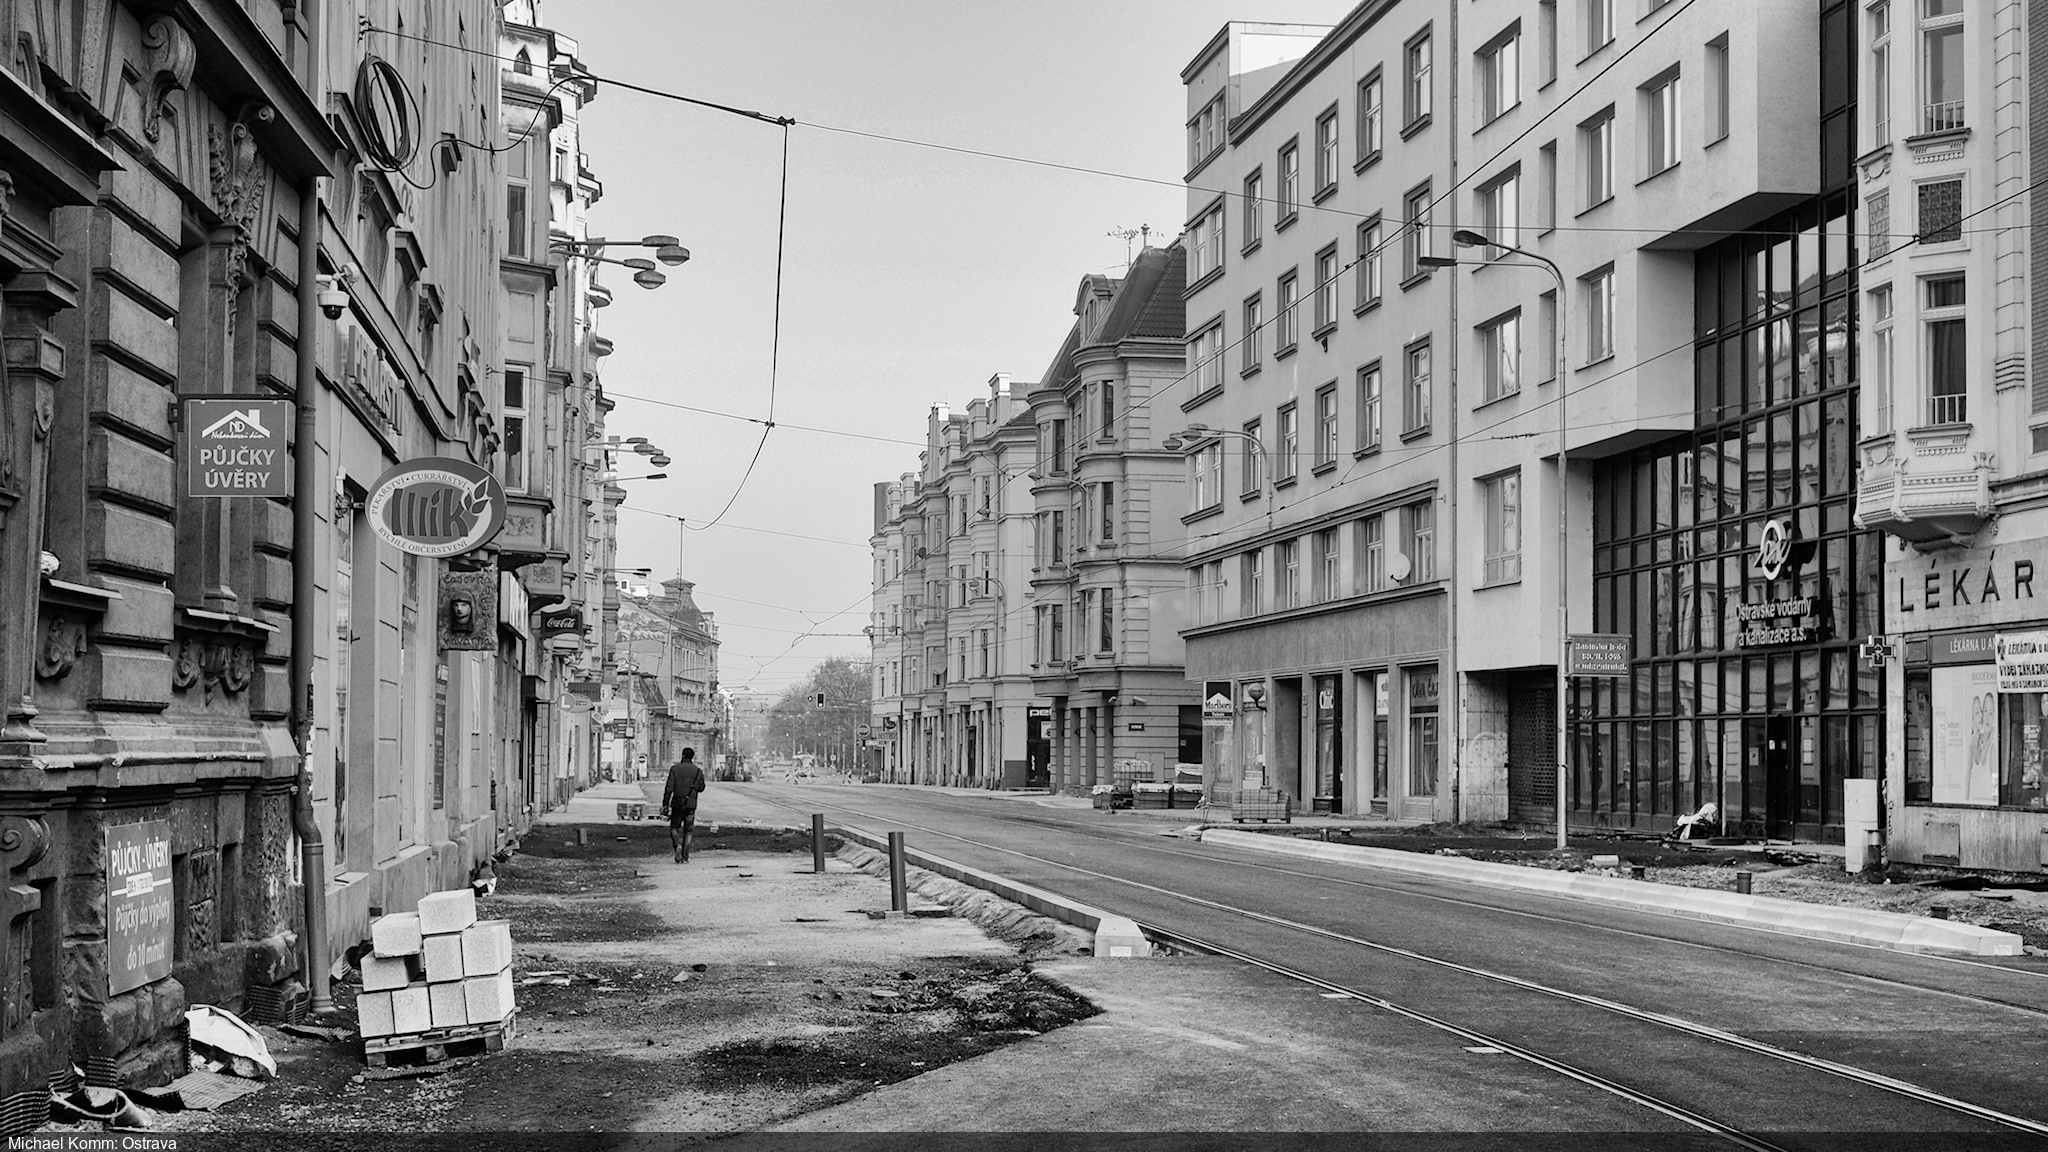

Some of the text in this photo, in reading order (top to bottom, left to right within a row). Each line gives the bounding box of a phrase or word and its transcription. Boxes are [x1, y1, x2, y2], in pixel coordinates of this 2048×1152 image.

[200, 444, 276, 466] PŮJČKY
[205, 468, 271, 489] ÚVĚRY
[371, 471, 468, 515] PEKAŘSTVÍ CUKRÁŘSTVÍ
[378, 526, 468, 555] RYCHLÉ OBČERSTVENÍ
[1900, 549, 2035, 613] LÉKÁR
[1736, 595, 1812, 621] Ostravské vodárny
[1738, 626, 1807, 646] a kanalizace a.s.
[1950, 637, 1980, 653] LÉKÁRNA
[1981, 638, 1987, 651] U
[1205, 699, 1232, 710] Marlboro
[111, 840, 141, 877] PŮJČKY
[145, 836, 169, 870] ÚVĚRY
[115, 895, 170, 936] Půjčky do výplaty
[127, 937, 165, 971] do 10 minut
